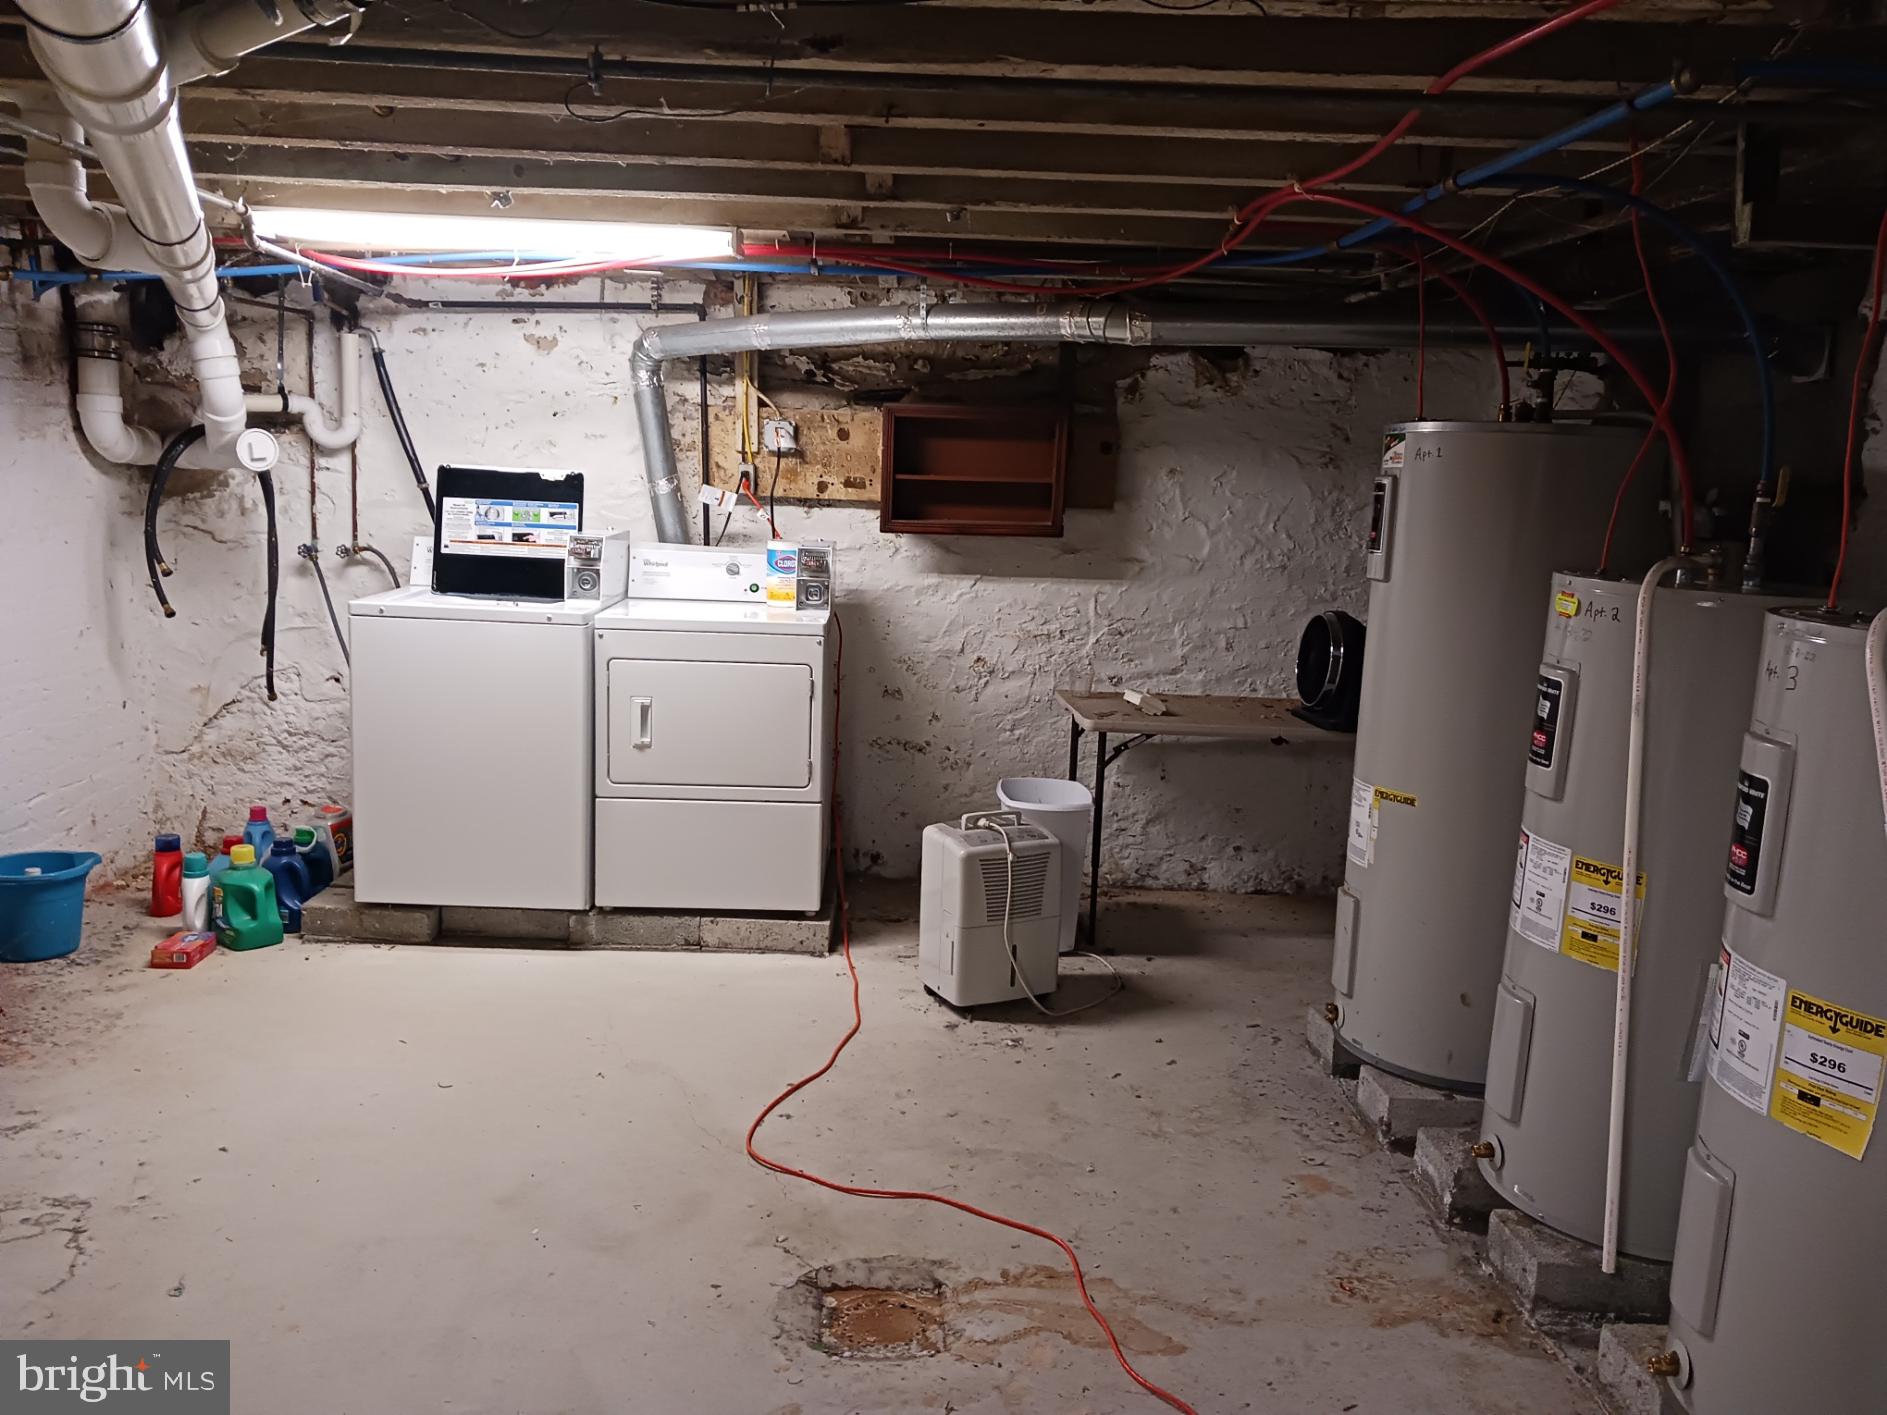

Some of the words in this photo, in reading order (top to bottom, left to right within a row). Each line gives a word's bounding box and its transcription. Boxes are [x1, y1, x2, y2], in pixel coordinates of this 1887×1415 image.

[777, 560, 797, 568] CLORO
[1611, 607, 1621, 623] 2
[1784, 665, 1799, 691] 3
[1575, 860, 1644, 886] ENERGYGUE
[1590, 901, 1616, 916] $296
[1790, 994, 1886, 1038] ENERGYGUIDE
[1809, 1052, 1847, 1073] $296
